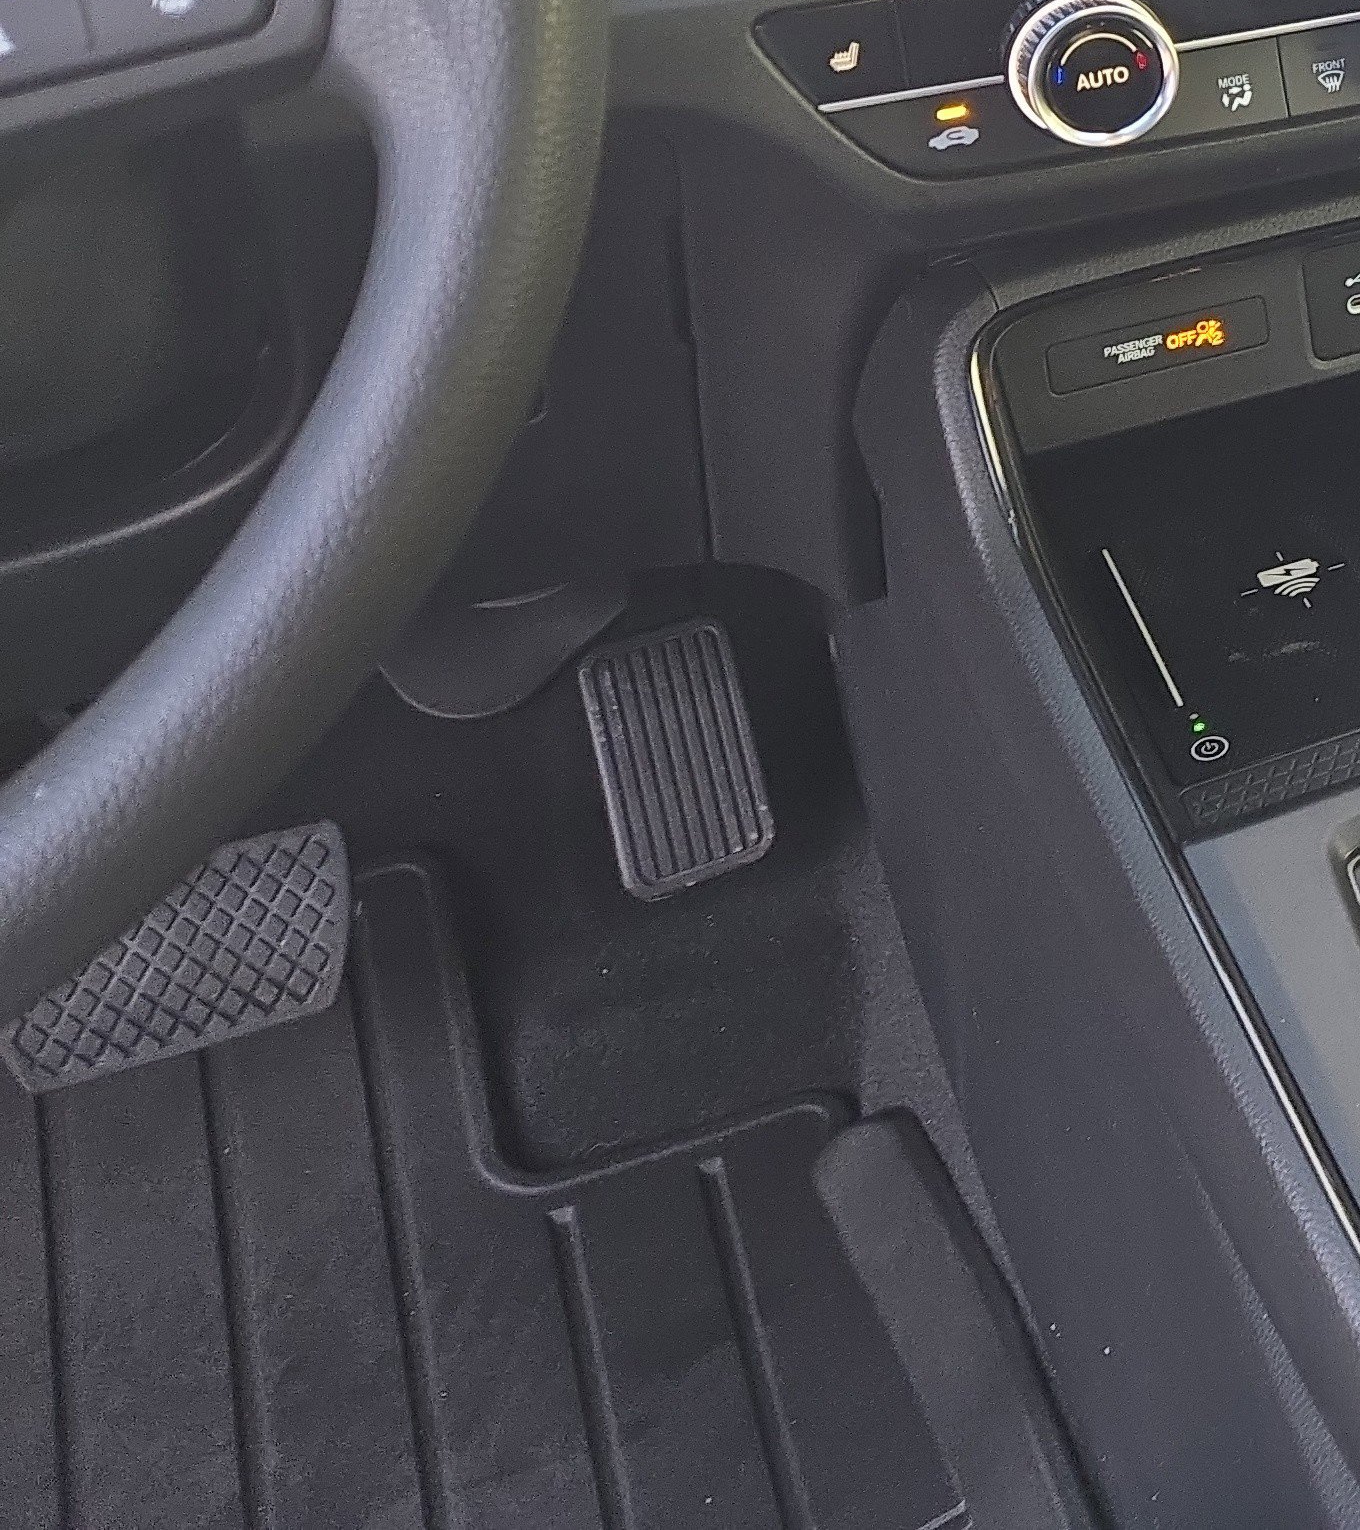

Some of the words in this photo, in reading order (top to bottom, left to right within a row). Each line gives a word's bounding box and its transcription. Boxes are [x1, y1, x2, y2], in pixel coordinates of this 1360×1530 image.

[1312, 58, 1346, 73] FRONT
[1076, 66, 1130, 92] AUTO
[1218, 73, 1250, 89] MODE
[1103, 334, 1163, 358] PASSENGER
[1166, 329, 1198, 350] OFF
[1117, 346, 1156, 365] AIRBAG
